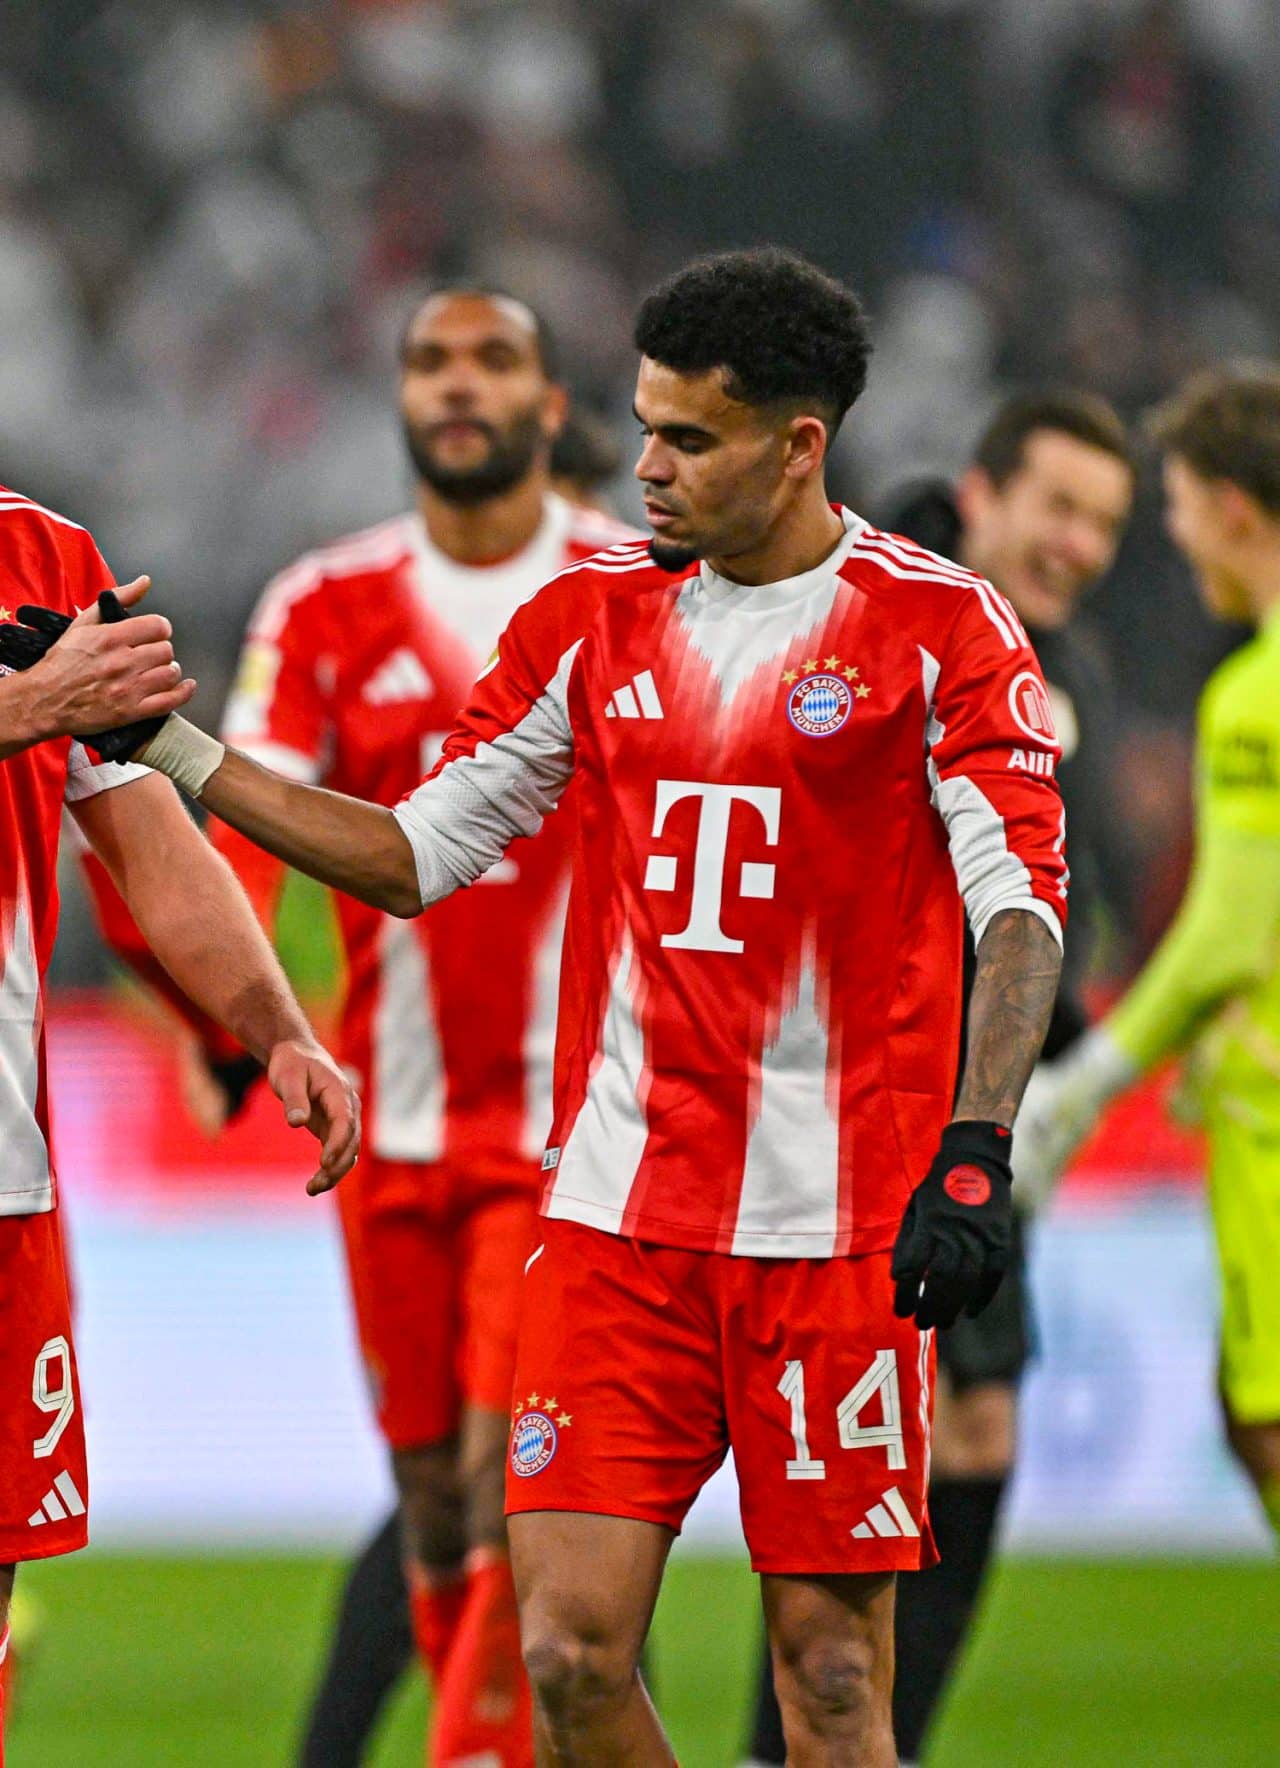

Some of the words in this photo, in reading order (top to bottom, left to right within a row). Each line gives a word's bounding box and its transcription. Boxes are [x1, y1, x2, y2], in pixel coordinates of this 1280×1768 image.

[796, 684, 811, 698] FC
[812, 679, 849, 704] BAYERN
[643, 779, 783, 954] T
[32, 1335, 75, 1459] 9
[776, 1349, 908, 1480] 14
